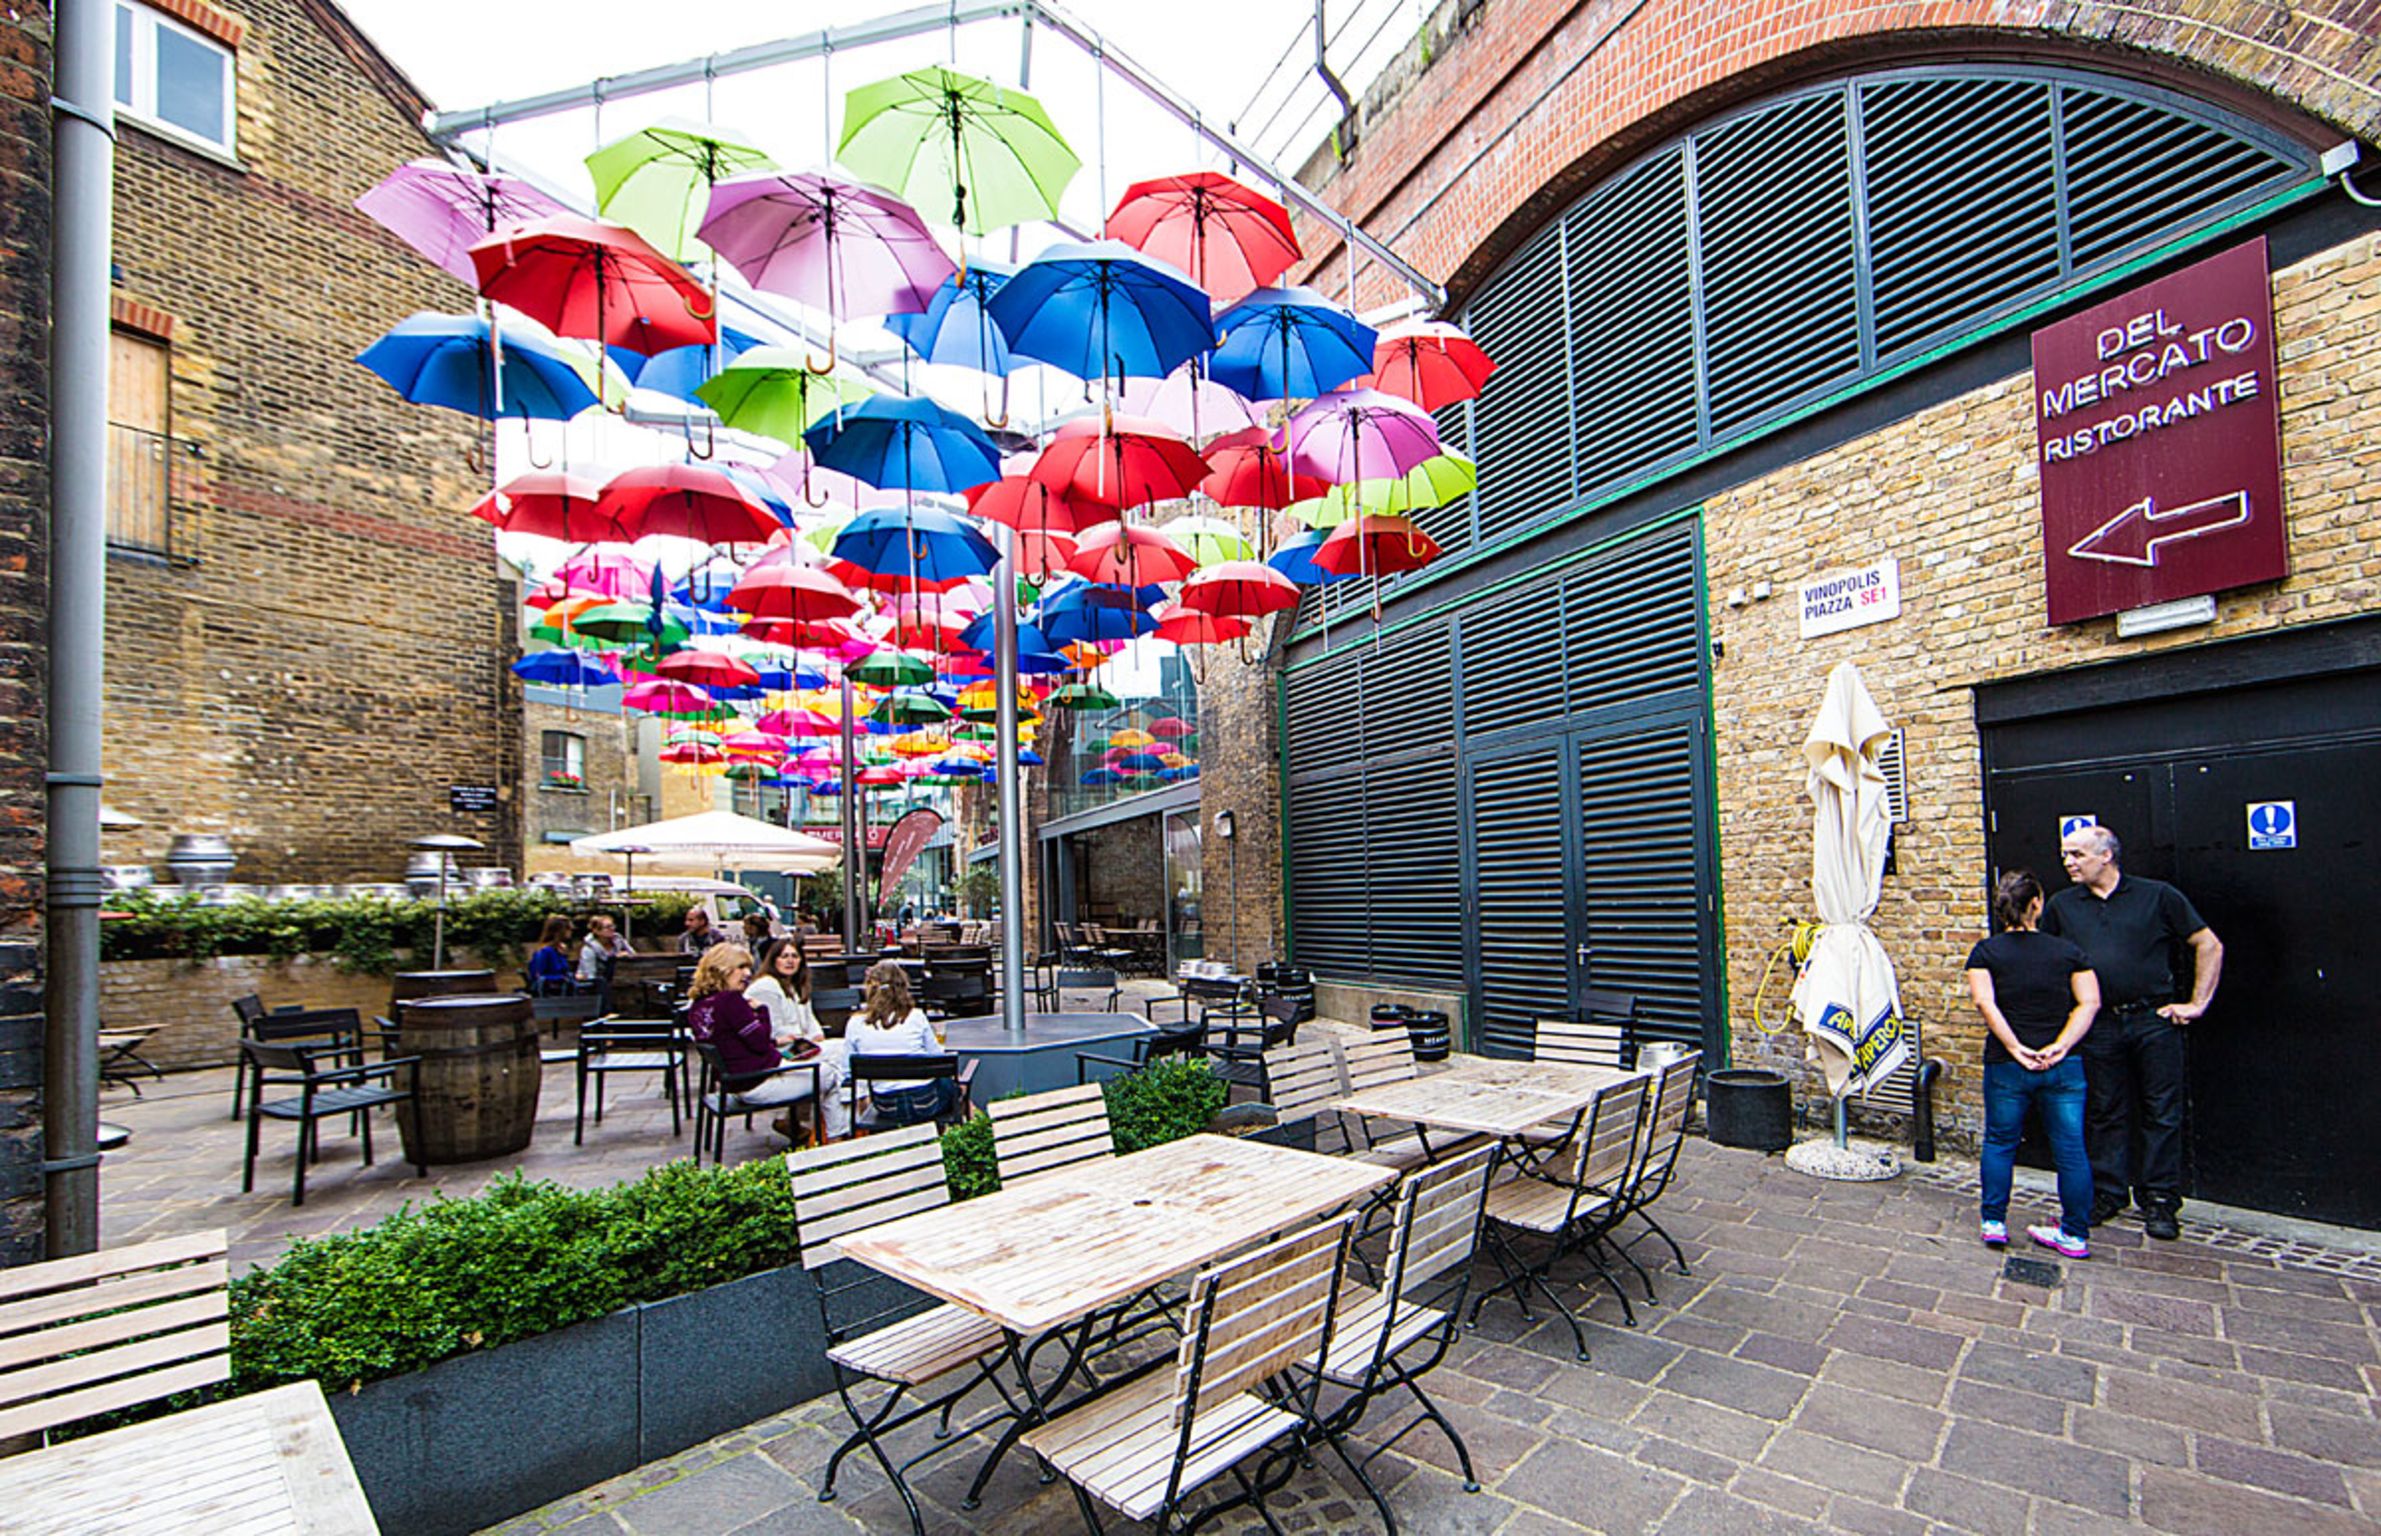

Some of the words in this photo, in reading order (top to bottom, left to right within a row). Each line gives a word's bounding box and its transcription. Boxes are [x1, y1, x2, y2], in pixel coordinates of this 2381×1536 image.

[2096, 308, 2187, 361] DEL
[2042, 317, 2256, 418] MERCATO
[2043, 371, 2260, 463] RISTORANTE
[1804, 570, 1881, 602] VINOPOLIS
[1804, 596, 1854, 620] PIAZZA
[1860, 586, 1887, 606] SE1
